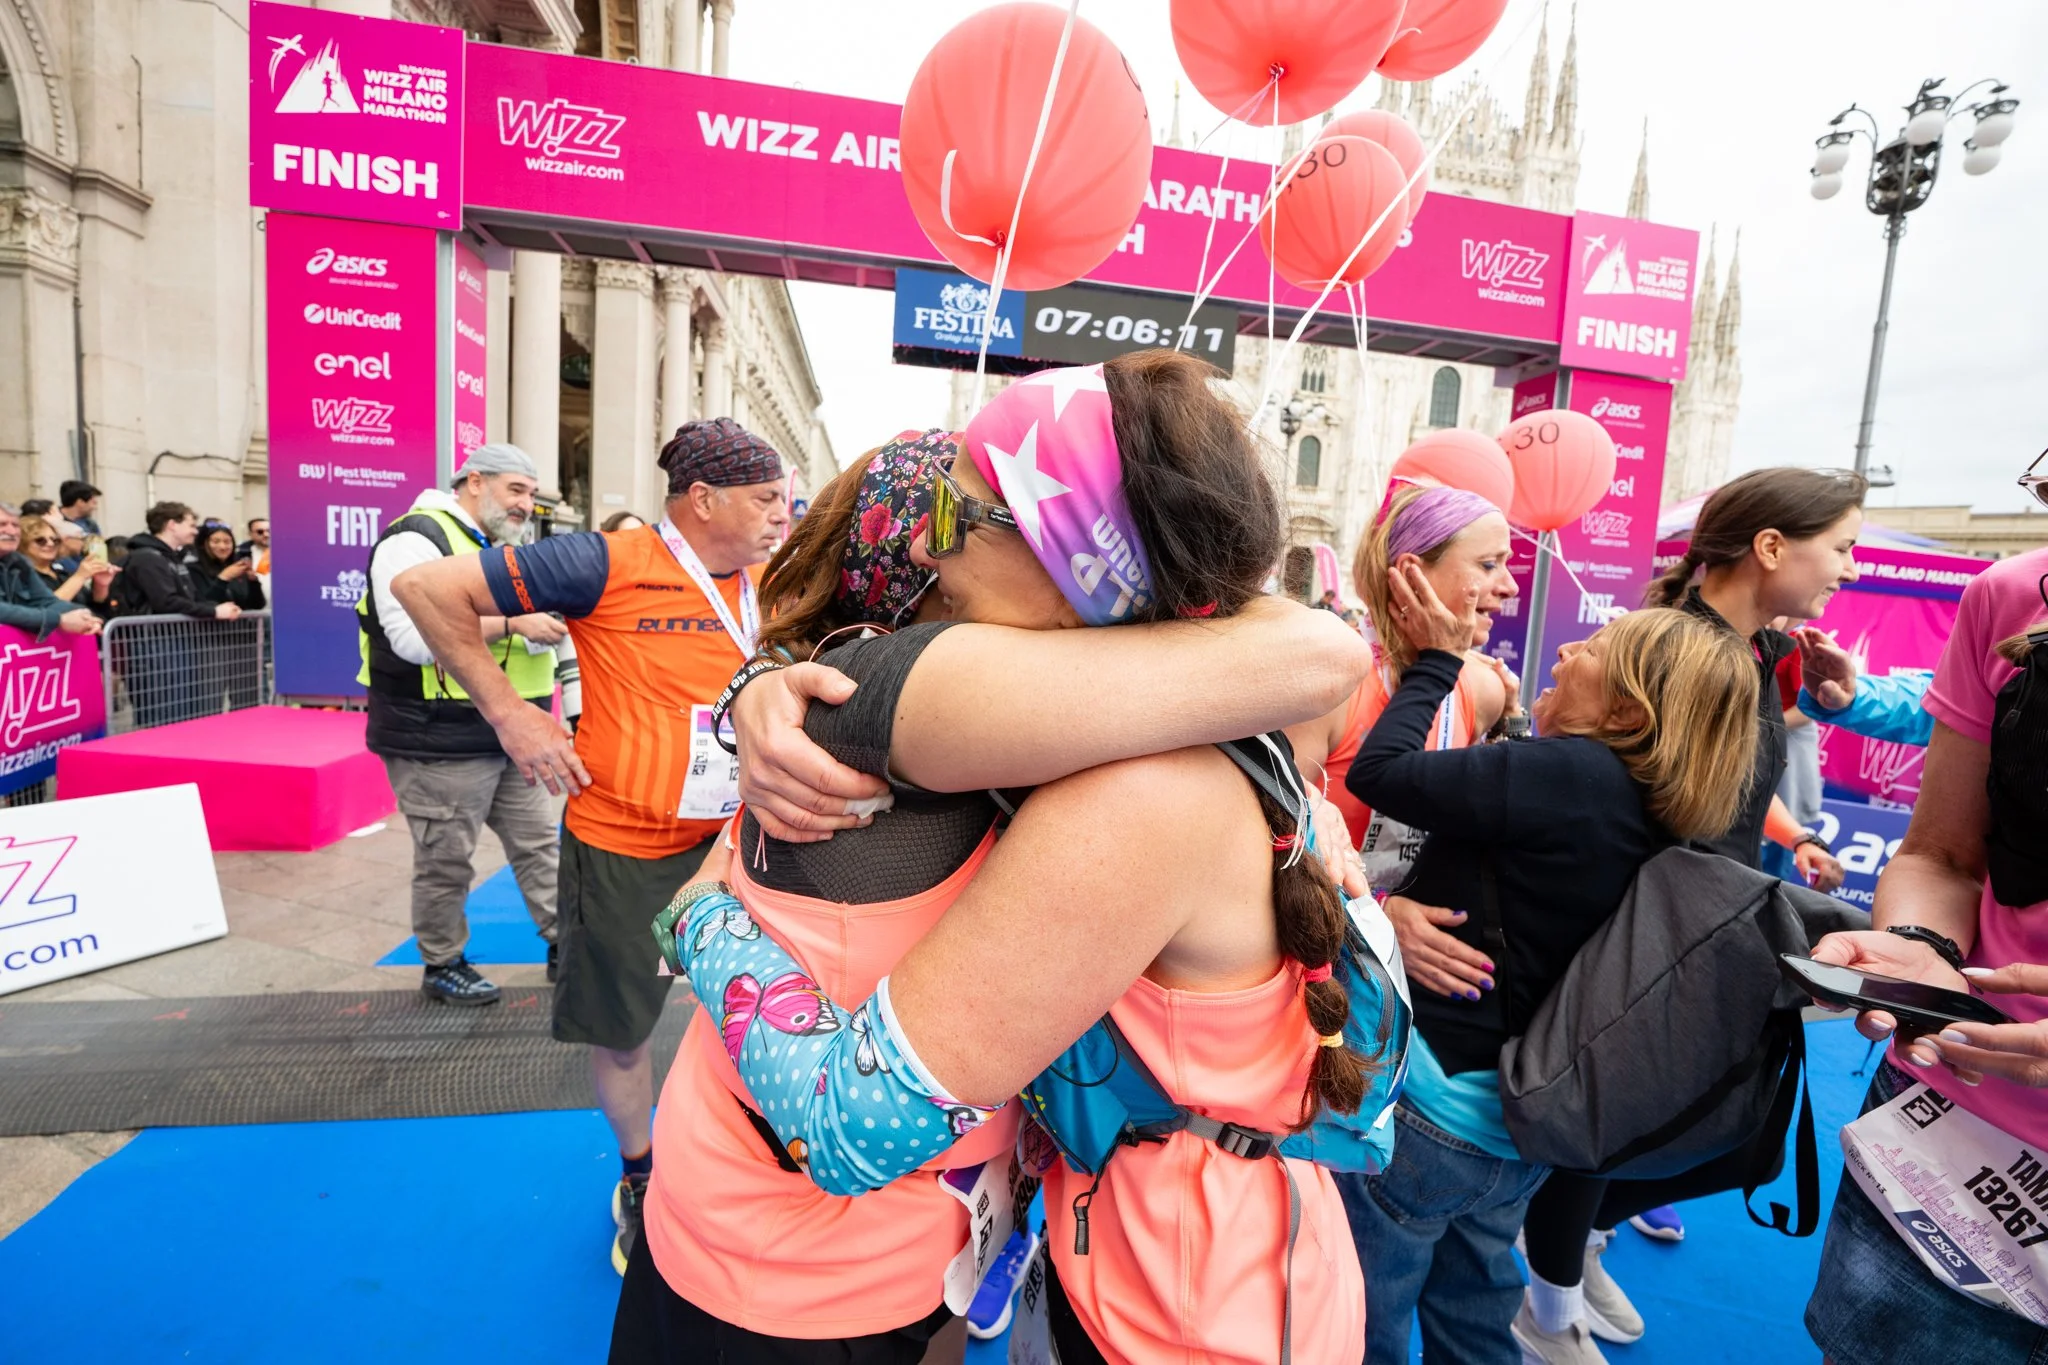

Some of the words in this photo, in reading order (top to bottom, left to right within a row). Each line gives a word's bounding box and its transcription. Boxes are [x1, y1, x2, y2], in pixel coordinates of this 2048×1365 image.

[363, 69, 412, 88] WIZZ
[415, 76, 447, 94] AIR
[363, 84, 448, 111] MILANO
[363, 102, 447, 124] MARATHON
[697, 111, 819, 160] WIZZ
[830, 132, 902, 172] AIR
[273, 143, 438, 199] FINISH
[525, 156, 625, 181] wizzair.com
[332, 254, 388, 277] asics
[1478, 286, 1545, 307] wizzair.com
[325, 307, 401, 331] UniCredit
[913, 307, 1015, 338] FESTINA
[1035, 307, 1224, 352] 07:06:11
[1577, 316, 1677, 358] FINISH
[314, 352, 392, 380] enel
[331, 433, 395, 446] wizzair.com
[299, 463, 326, 479] BW
[334, 466, 359, 479] Best
[327, 505, 382, 547] FIAT
[1876, 564, 1925, 582] MILANO
[731, 673, 747, 689] de
[712, 687, 733, 721] Ruhr
[1849, 1149, 1866, 1172] TRUCK
[1963, 1165, 2048, 1249] 13267
[1928, 1235, 1967, 1268] asics
